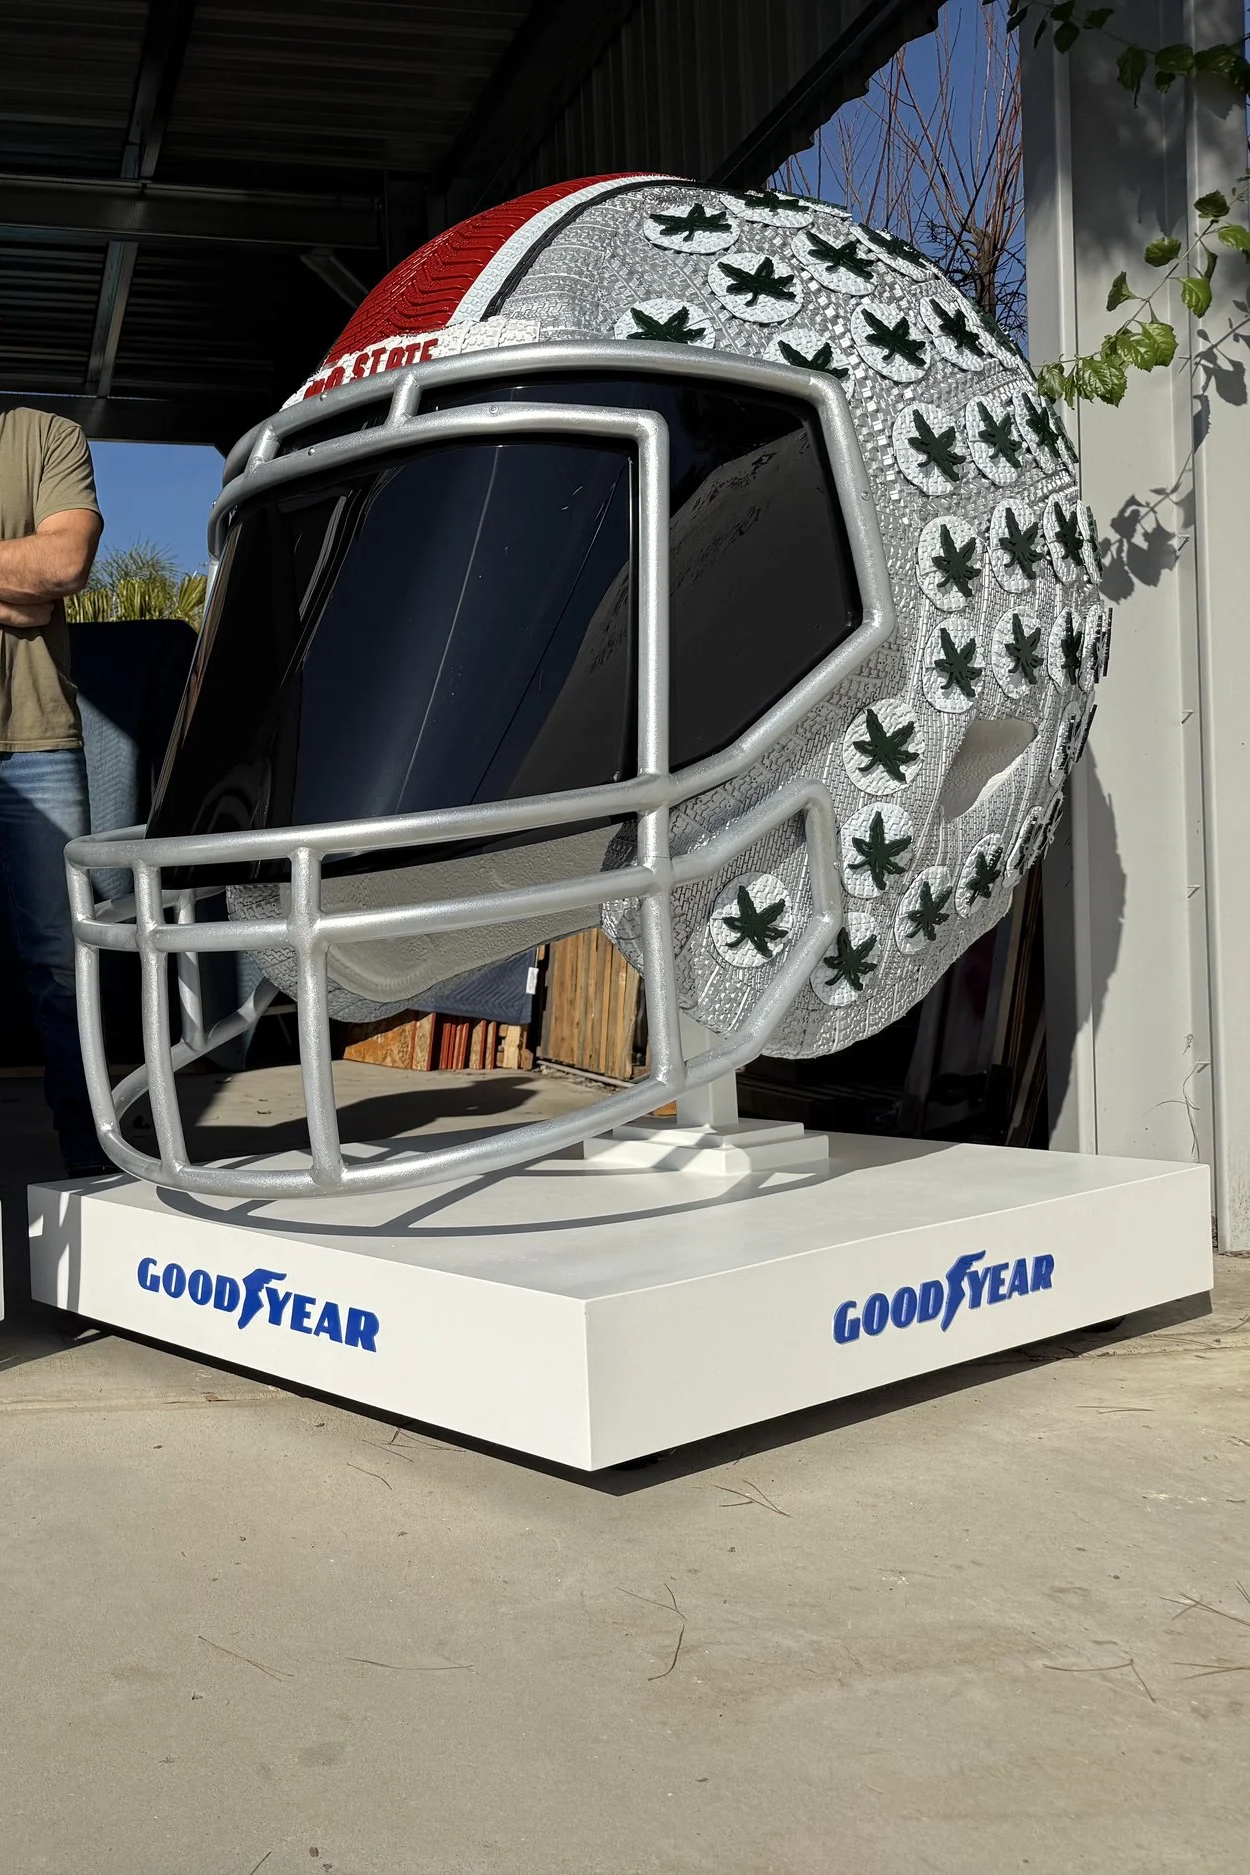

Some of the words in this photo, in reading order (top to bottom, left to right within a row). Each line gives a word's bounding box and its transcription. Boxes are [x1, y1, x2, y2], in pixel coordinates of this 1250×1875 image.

[350, 337, 439, 381] STATE
[137, 1257, 380, 1352] GOODYEAR
[833, 1250, 1055, 1345] GOODYEAR
